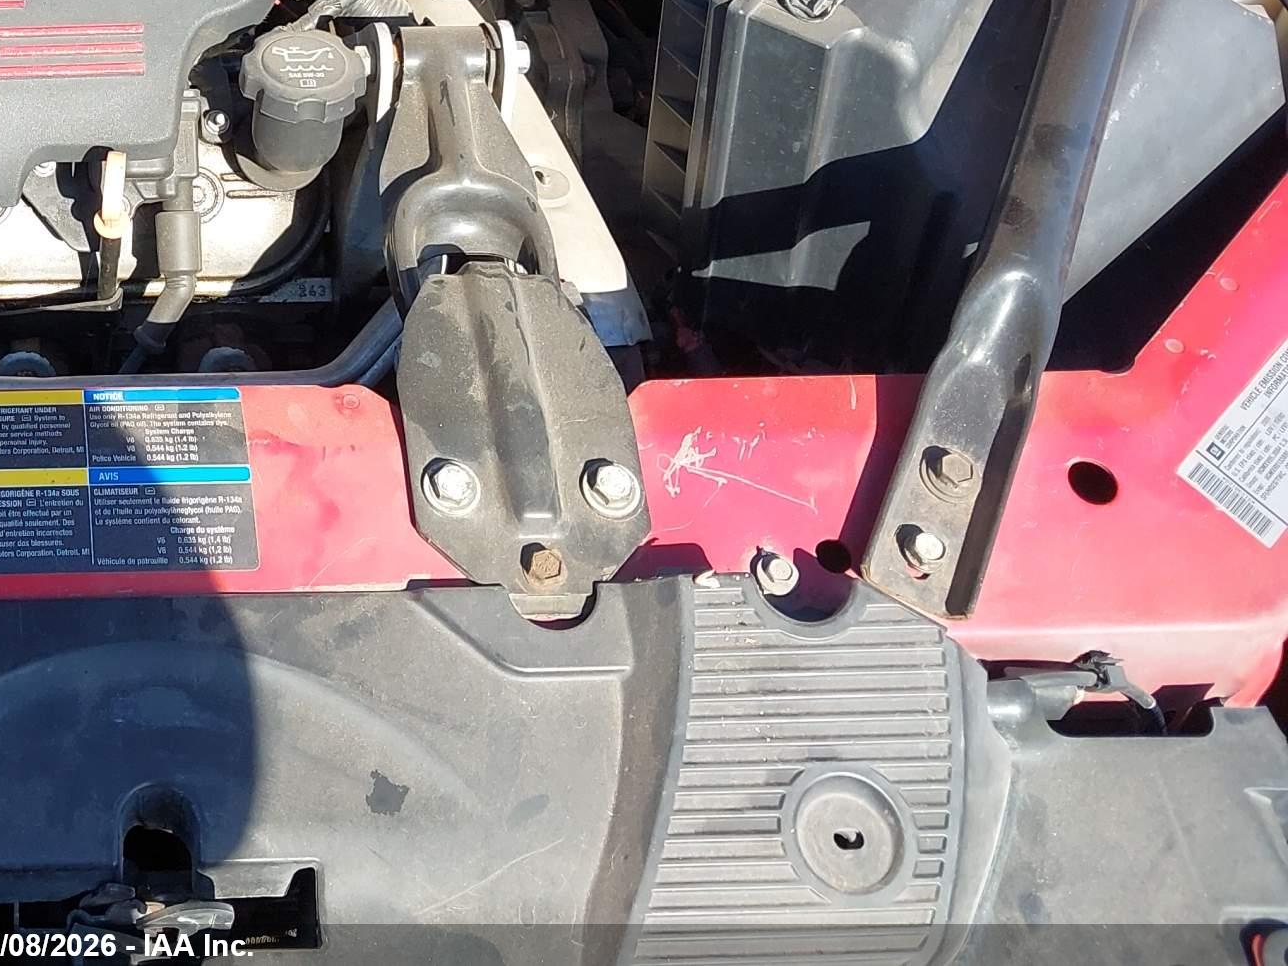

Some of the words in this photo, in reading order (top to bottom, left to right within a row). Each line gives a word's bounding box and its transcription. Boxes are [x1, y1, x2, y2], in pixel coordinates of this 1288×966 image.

[1240, 386, 1263, 410] VEHICLE
[1258, 361, 1283, 389] EMISSION
[93, 392, 123, 400] NOTICE
[165, 436, 173, 444] kg
[167, 454, 175, 462] kg
[99, 472, 118, 481] AVIS
[94, 488, 138, 496] CLIMATISEUR
